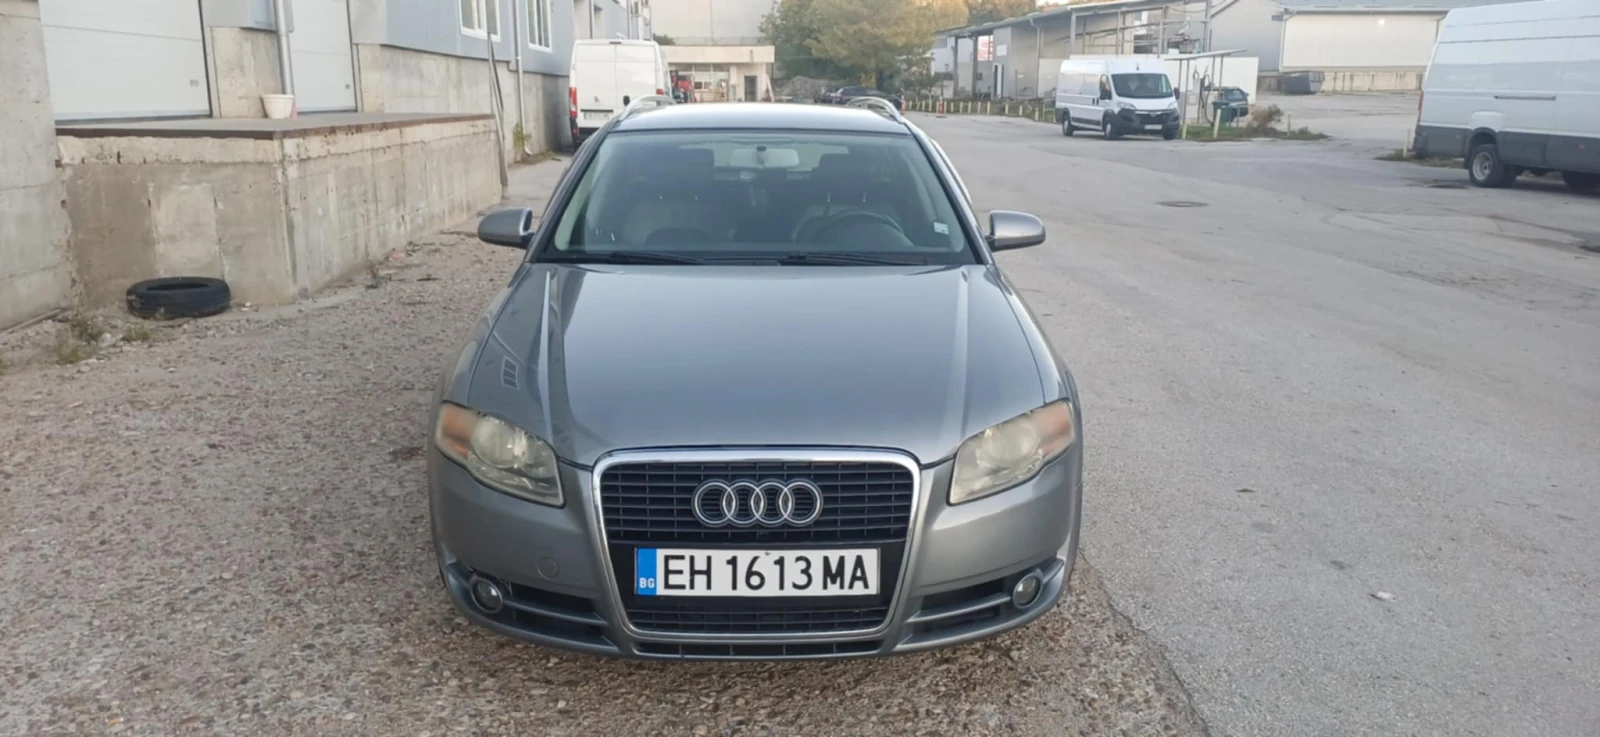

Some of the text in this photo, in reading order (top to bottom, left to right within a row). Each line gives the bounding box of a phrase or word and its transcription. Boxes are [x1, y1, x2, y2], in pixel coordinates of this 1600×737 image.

[639, 577, 655, 588] BG
[663, 554, 869, 591] EH 1613 MA
